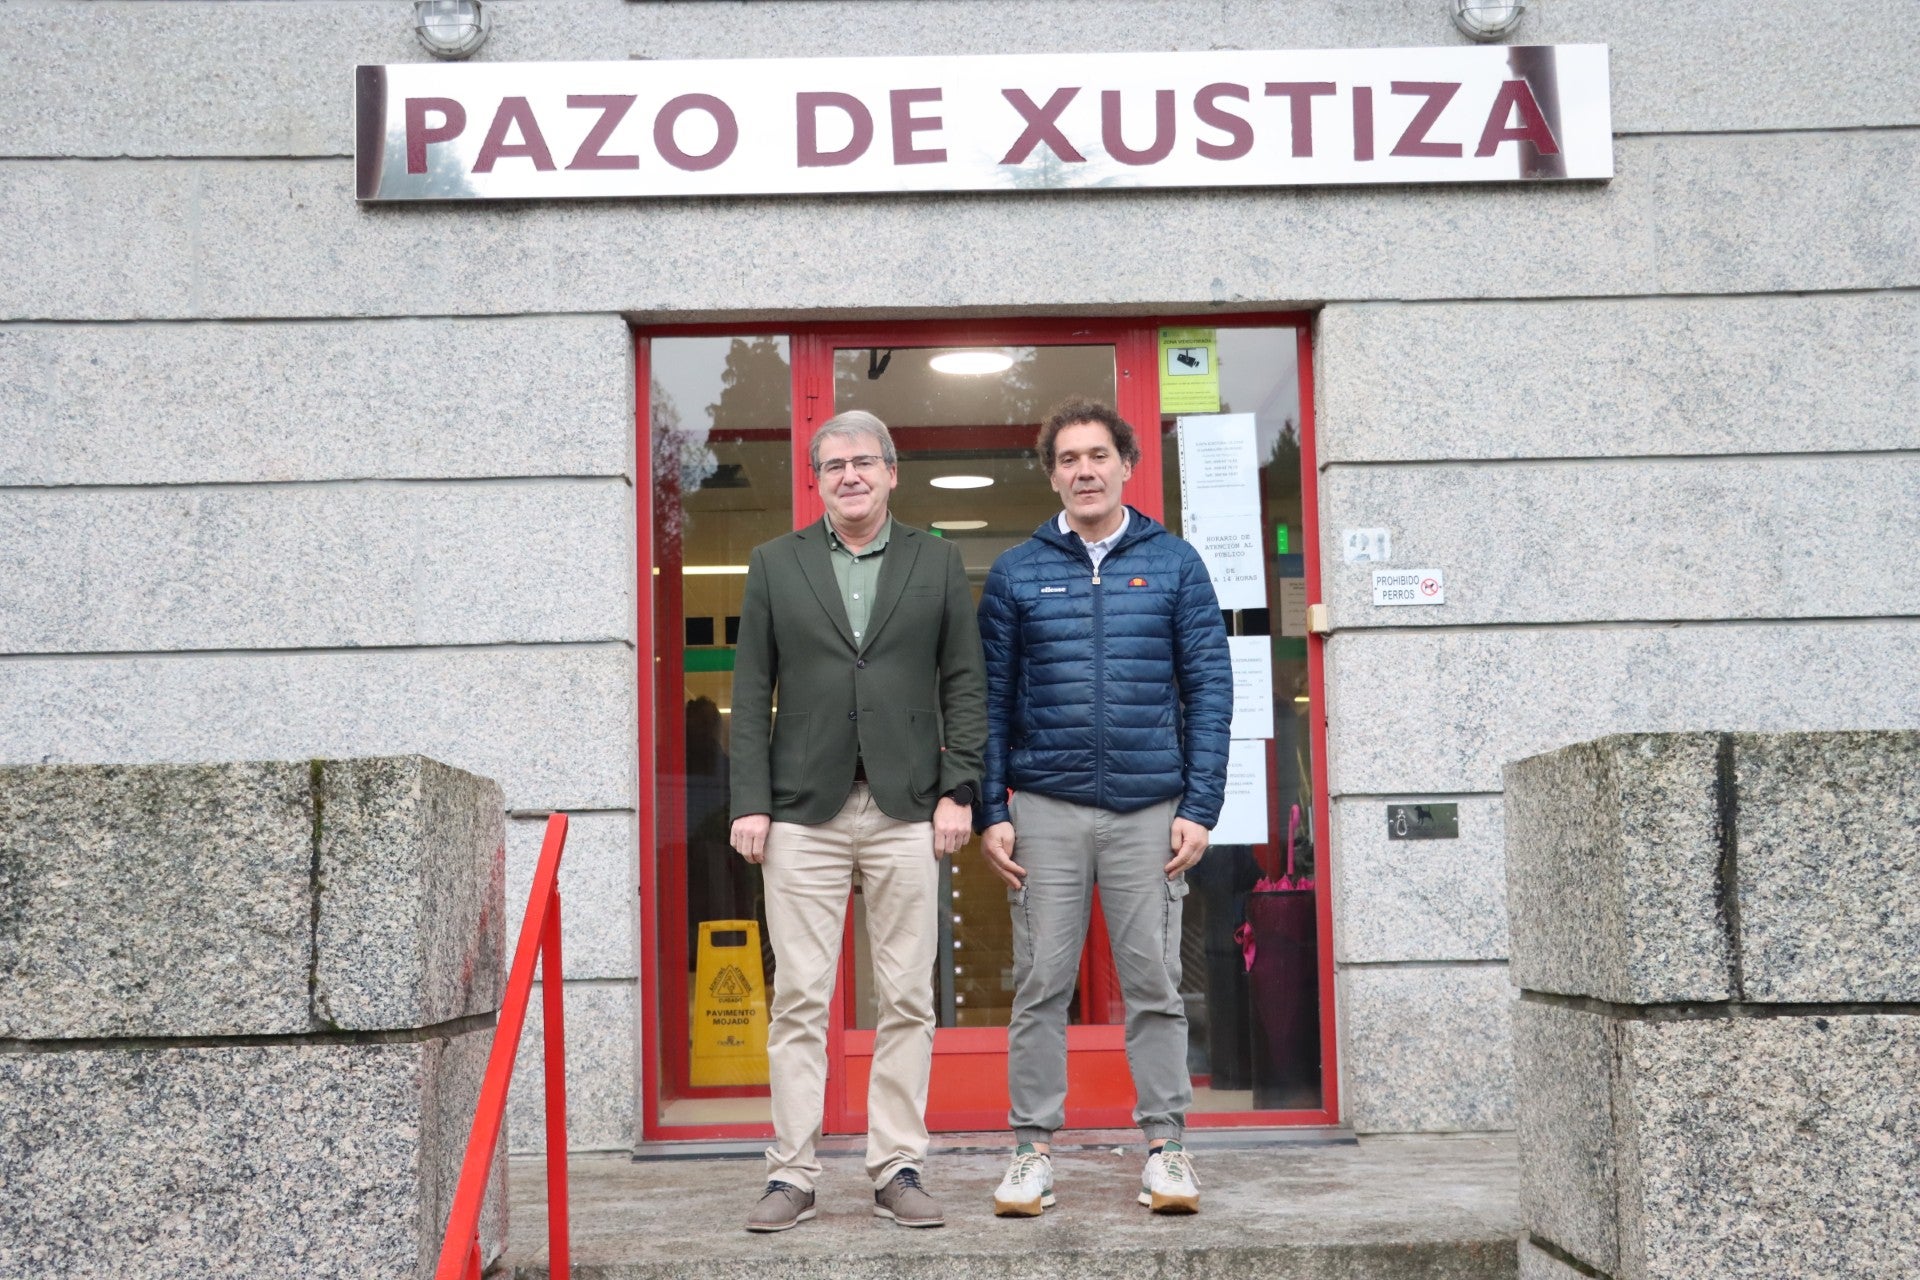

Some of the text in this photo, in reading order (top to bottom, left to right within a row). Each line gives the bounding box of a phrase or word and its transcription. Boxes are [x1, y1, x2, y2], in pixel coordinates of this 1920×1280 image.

[405, 79, 1561, 174] PAZO DE XUSTIZA
[1376, 575, 1420, 586] PROHIBIDO
[1382, 590, 1415, 600] PERROS
[706, 1009, 756, 1017] PAVIMENTO
